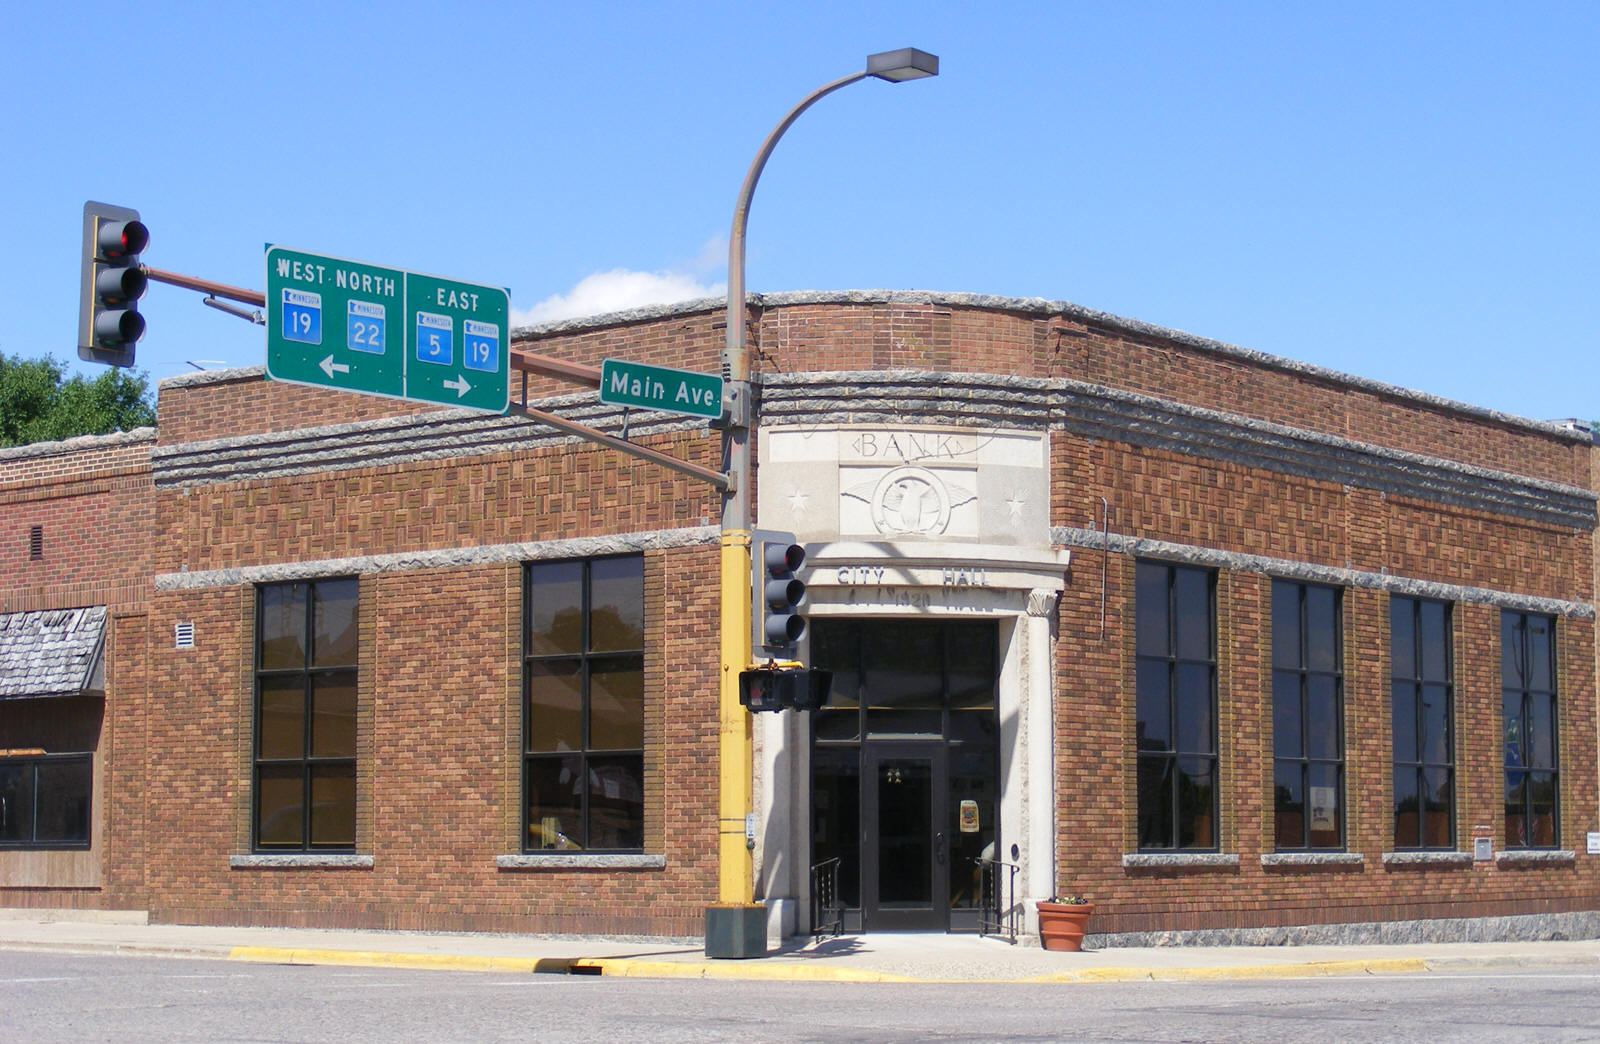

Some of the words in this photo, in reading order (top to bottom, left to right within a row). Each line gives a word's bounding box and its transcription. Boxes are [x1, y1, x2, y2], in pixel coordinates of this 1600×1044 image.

[276, 258, 325, 284] WEST
[336, 269, 395, 297] NORTH
[292, 293, 320, 305] MINNESOTA
[437, 287, 479, 312] EAST
[292, 311, 312, 335] 19
[353, 322, 379, 346] 22
[429, 334, 441, 356] 5
[472, 341, 490, 363] 19
[610, 370, 664, 400] Main
[675, 381, 714, 407] Ave
[861, 433, 955, 459] BANK
[836, 566, 885, 585] CITY
[942, 567, 990, 587] HALL
